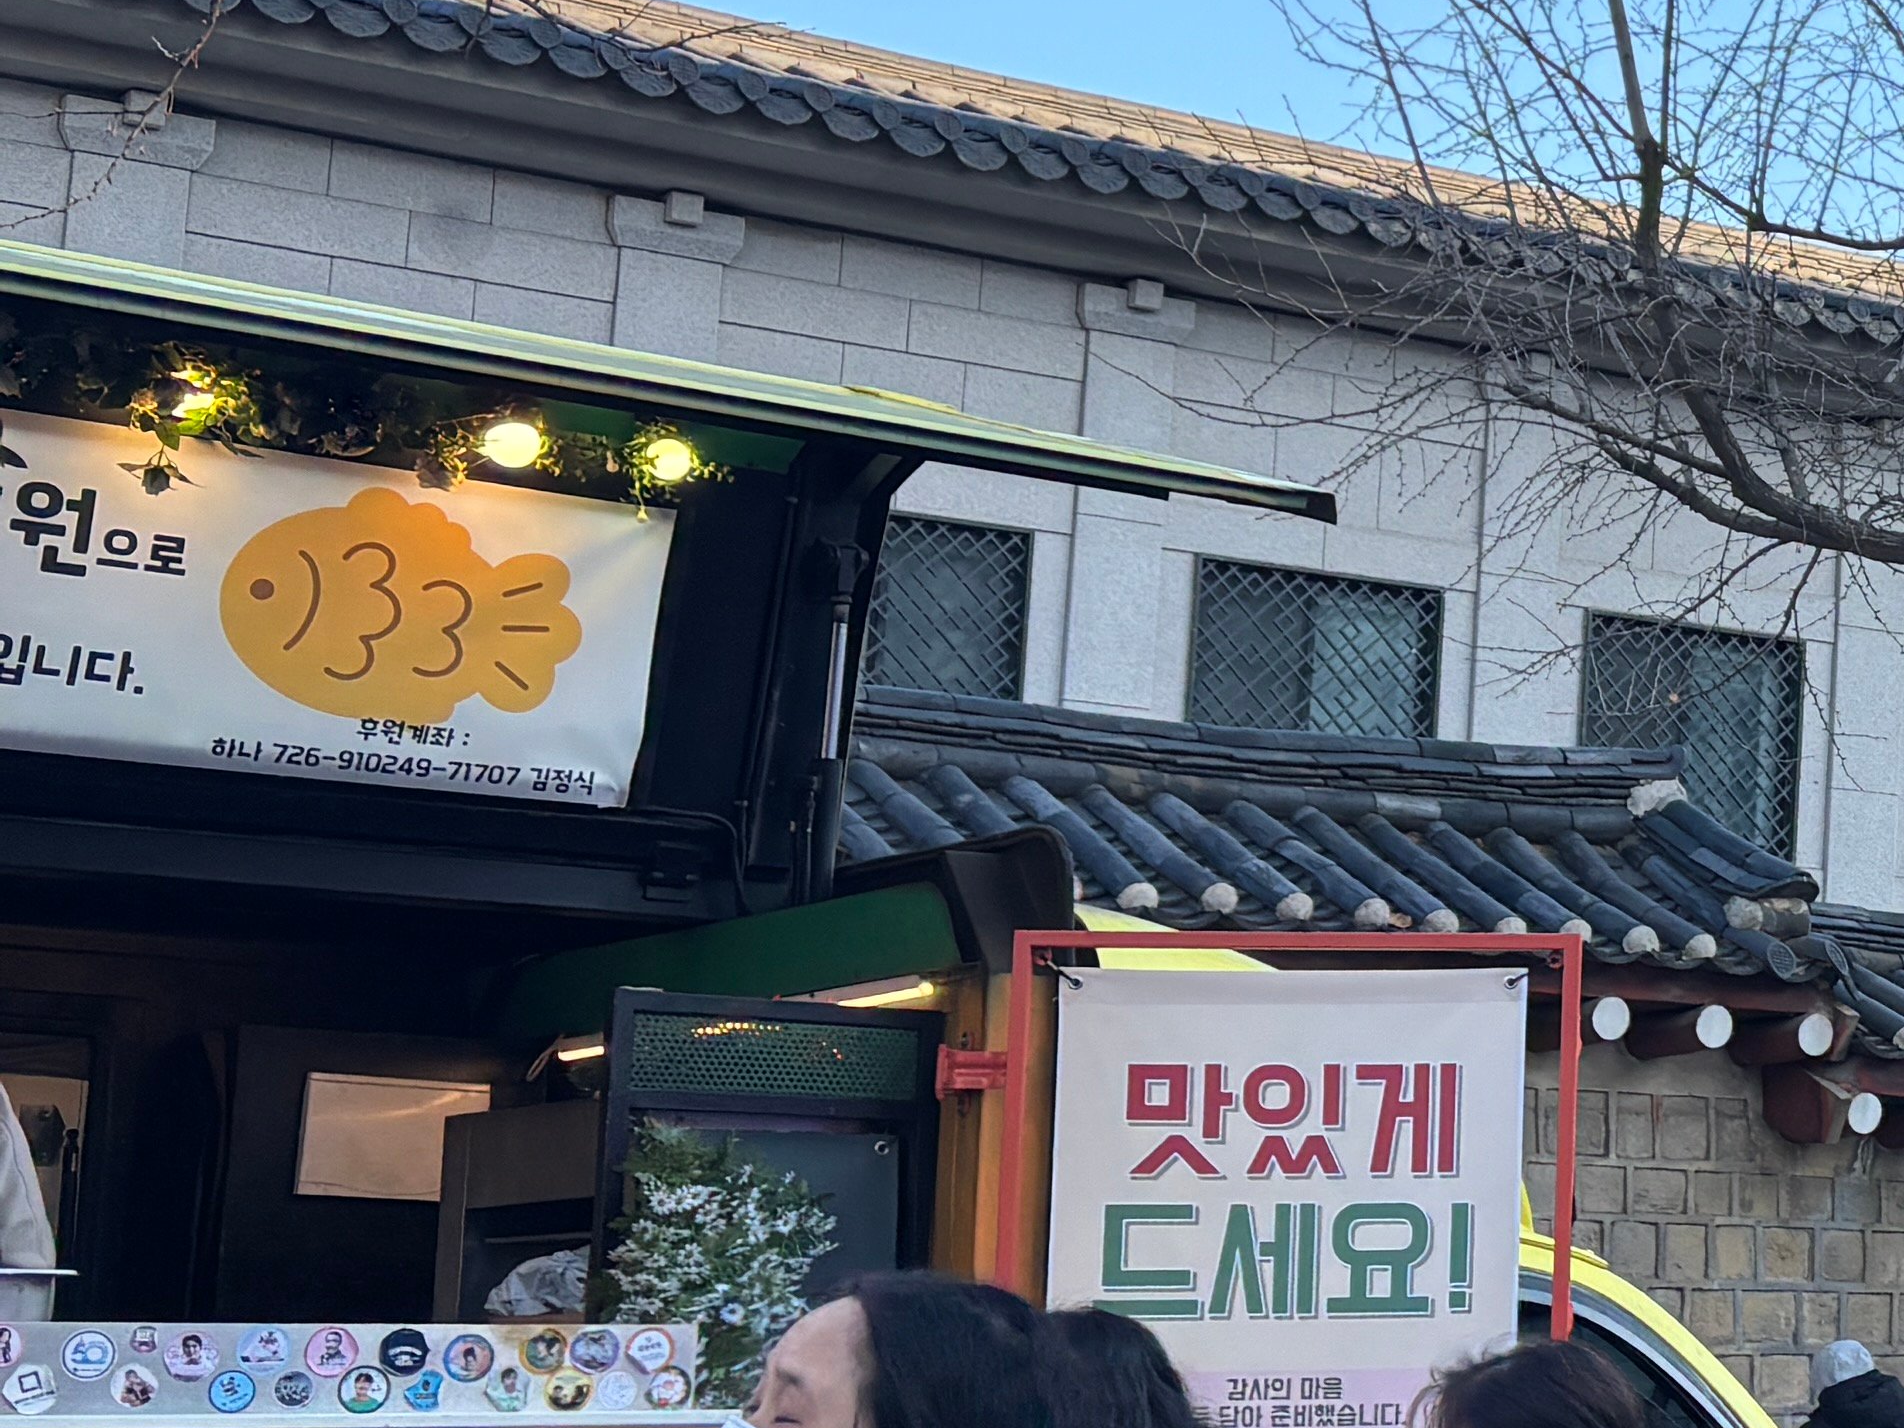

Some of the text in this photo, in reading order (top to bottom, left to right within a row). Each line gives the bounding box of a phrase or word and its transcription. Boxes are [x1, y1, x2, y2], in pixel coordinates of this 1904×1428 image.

[0, 481, 186, 577] 원으로
[356, 717, 454, 748] 후원계좌
[211, 737, 595, 795] 하나 726-910249-71707 김정식
[1126, 1062, 1463, 1178] 맛있게
[1091, 1202, 1474, 1319] 드세요!
[1219, 1405, 1262, 1428] 담아
[1226, 1376, 1342, 1401] 감사의 마음
